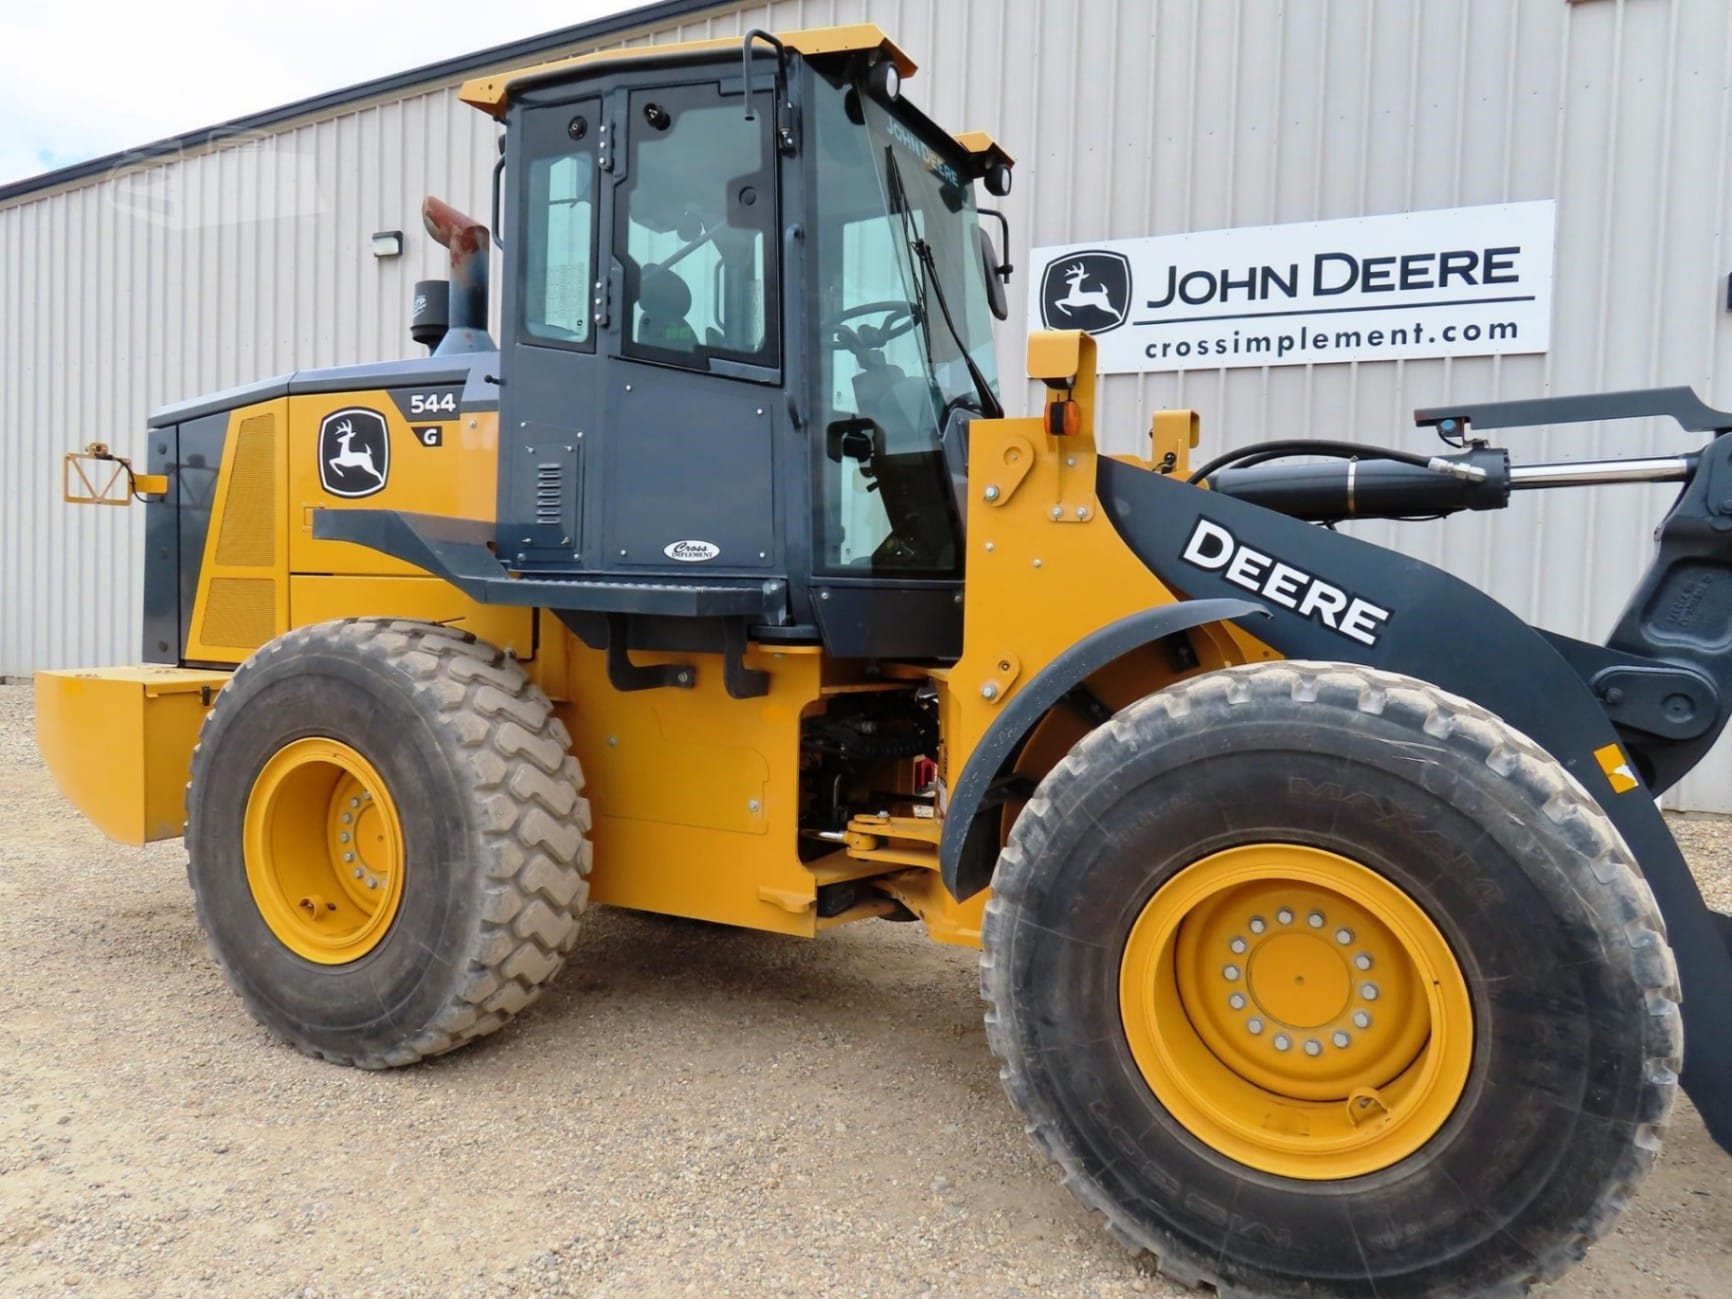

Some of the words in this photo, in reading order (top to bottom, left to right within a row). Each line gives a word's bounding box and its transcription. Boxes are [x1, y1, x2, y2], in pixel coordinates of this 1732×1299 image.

[1147, 263, 1298, 308] JOHN
[1313, 246, 1521, 296] DEERE
[1145, 321, 1518, 359] crossimplement.com
[410, 393, 456, 414] 544
[424, 428, 437, 445] G
[673, 541, 708, 553] Cross
[1182, 518, 1390, 646] DEERE
